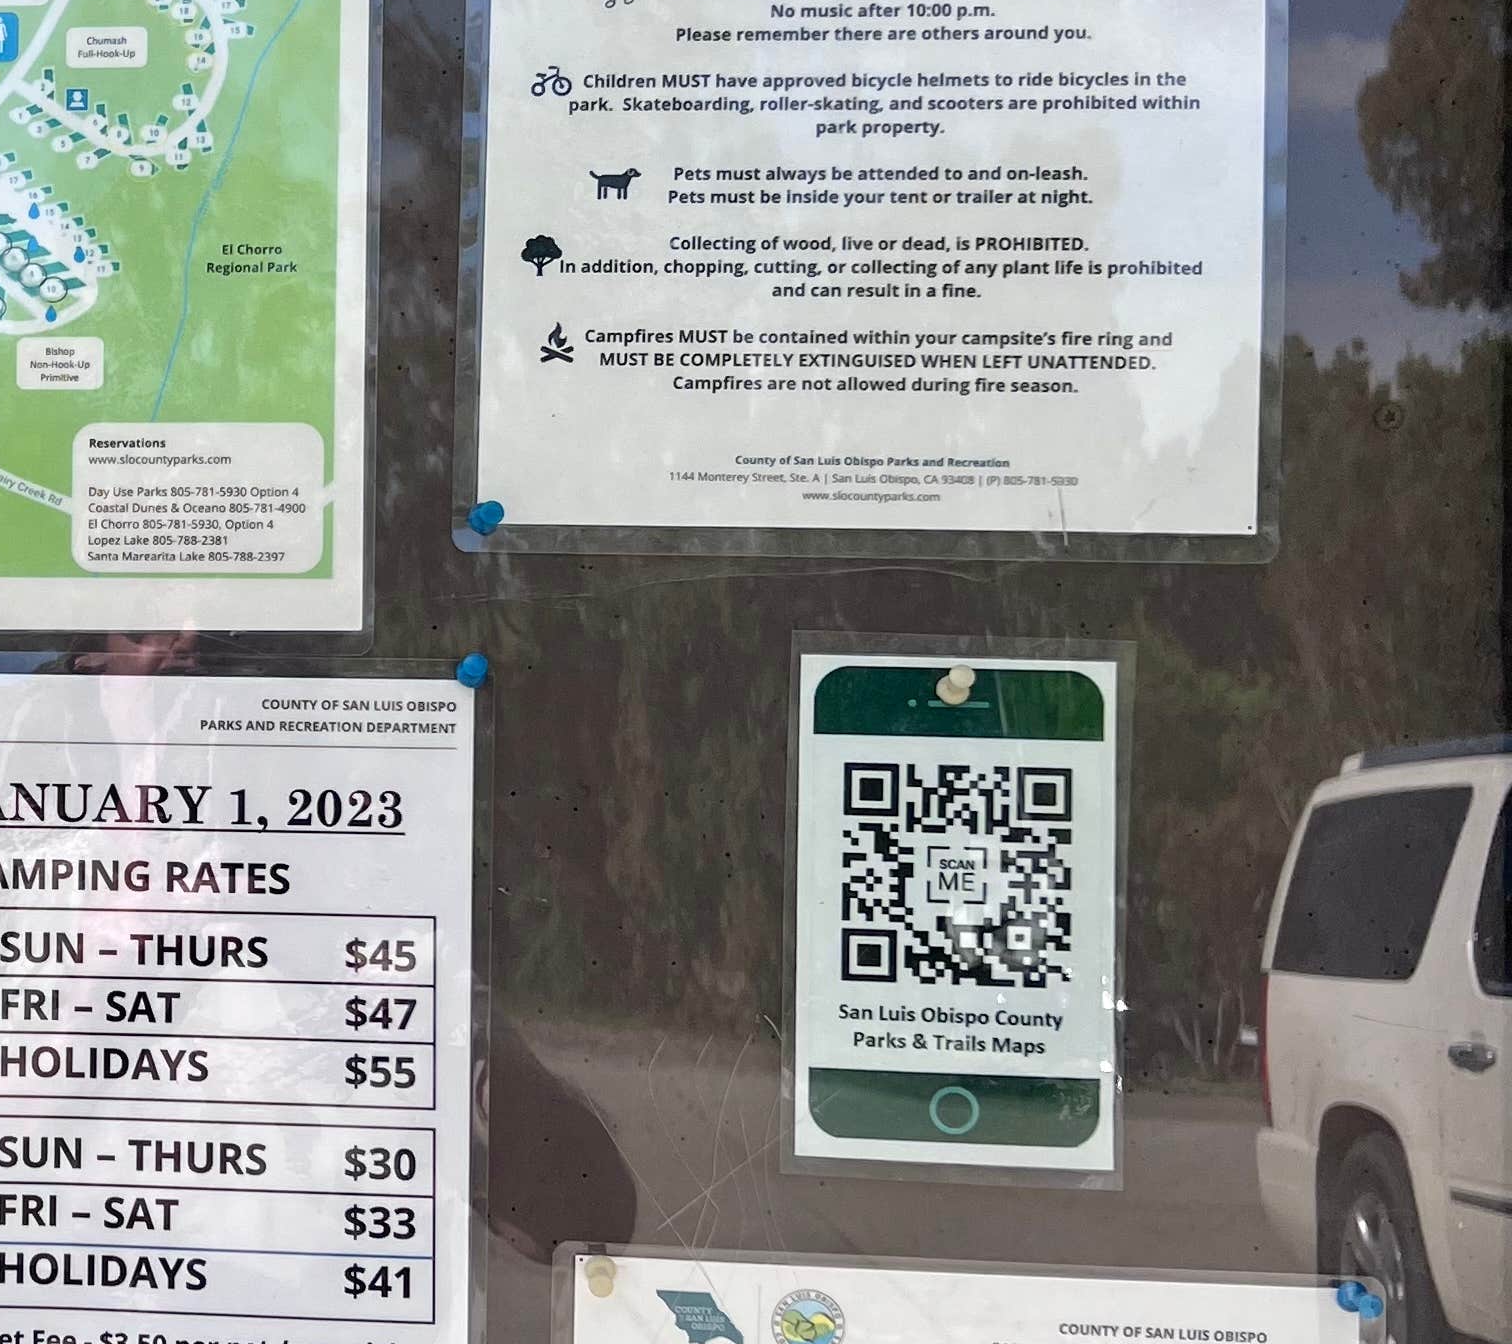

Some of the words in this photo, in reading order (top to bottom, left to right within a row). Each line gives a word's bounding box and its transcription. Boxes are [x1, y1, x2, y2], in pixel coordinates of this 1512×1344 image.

[86, 36, 127, 46] Chumash
[77, 48, 136, 60] Full-Hook-Up
[815, 119, 857, 138] park
[861, 121, 945, 138] property.
[222, 243, 234, 256] El
[237, 243, 283, 255] Chorro
[206, 261, 264, 277] Regional
[267, 261, 298, 273] Park
[45, 347, 76, 358] Bishop
[29, 359, 91, 370] Non-Hook-Up
[40, 373, 80, 382] Primitive
[673, 375, 762, 394] Campfires
[767, 379, 797, 391] are
[801, 378, 832, 391] not
[836, 376, 906, 392] allowed
[911, 377, 971, 396] during
[974, 377, 1006, 393] fire
[1010, 381, 1079, 393] season.
[89, 437, 166, 449] Reservations
[88, 453, 232, 468] www.slocountyparks.com
[17, 481, 46, 499] Creek
[48, 493, 63, 506] Rd
[801, 490, 941, 504] www.slocountyparks.com
[87, 535, 121, 548] Lopez
[123, 535, 150, 546] Lake
[152, 535, 228, 546] 805-788-2381
[230, 788, 268, 833] 1,
[288, 788, 404, 829] 2023
[939, 858, 975, 871] SCAN
[938, 871, 975, 892] ME
[345, 936, 417, 974] $45
[345, 995, 417, 1032] $47
[838, 1003, 873, 1021] San
[879, 1005, 916, 1022] Luis
[920, 1006, 990, 1028] Obispo
[994, 1009, 1063, 1032] County
[853, 1031, 907, 1049] Parks
[912, 1033, 928, 1050] &
[932, 1034, 987, 1052] Trails
[992, 1037, 1046, 1057] Maps
[0, 1045, 209, 1082] HOLIDAYS
[345, 1053, 416, 1090] $55
